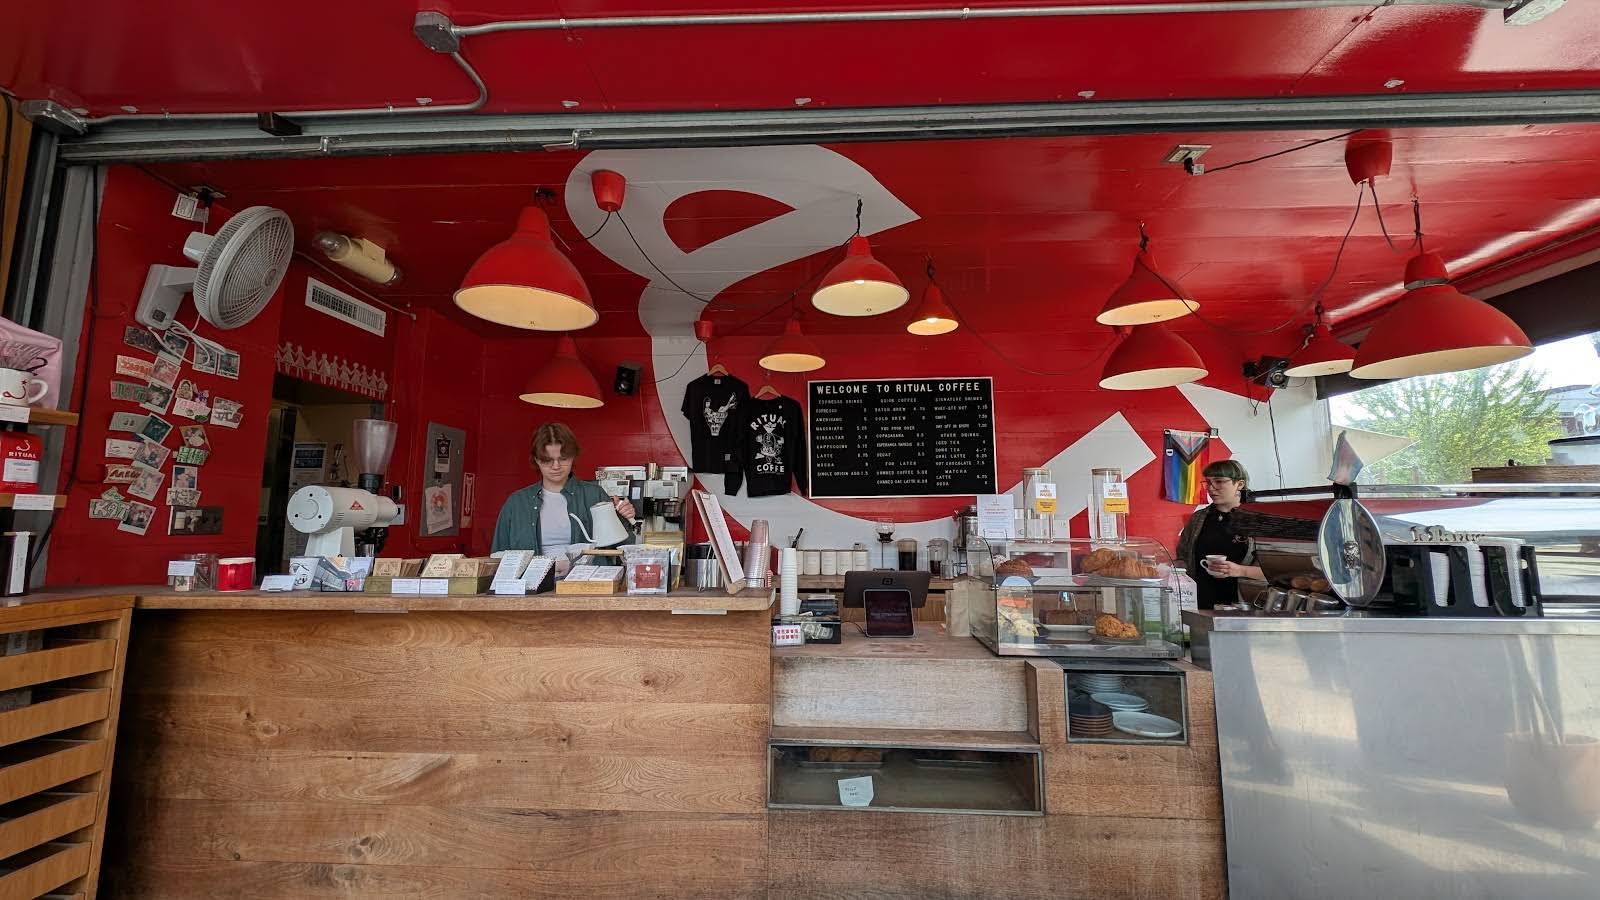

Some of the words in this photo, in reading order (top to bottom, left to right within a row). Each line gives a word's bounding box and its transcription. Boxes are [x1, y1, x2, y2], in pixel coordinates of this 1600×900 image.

[817, 385, 868, 394] WELCOME
[877, 385, 889, 393] TO
[896, 383, 933, 393] RITUAL
[939, 382, 980, 392] COFFEE
[8, 451, 37, 459] RITUAL
